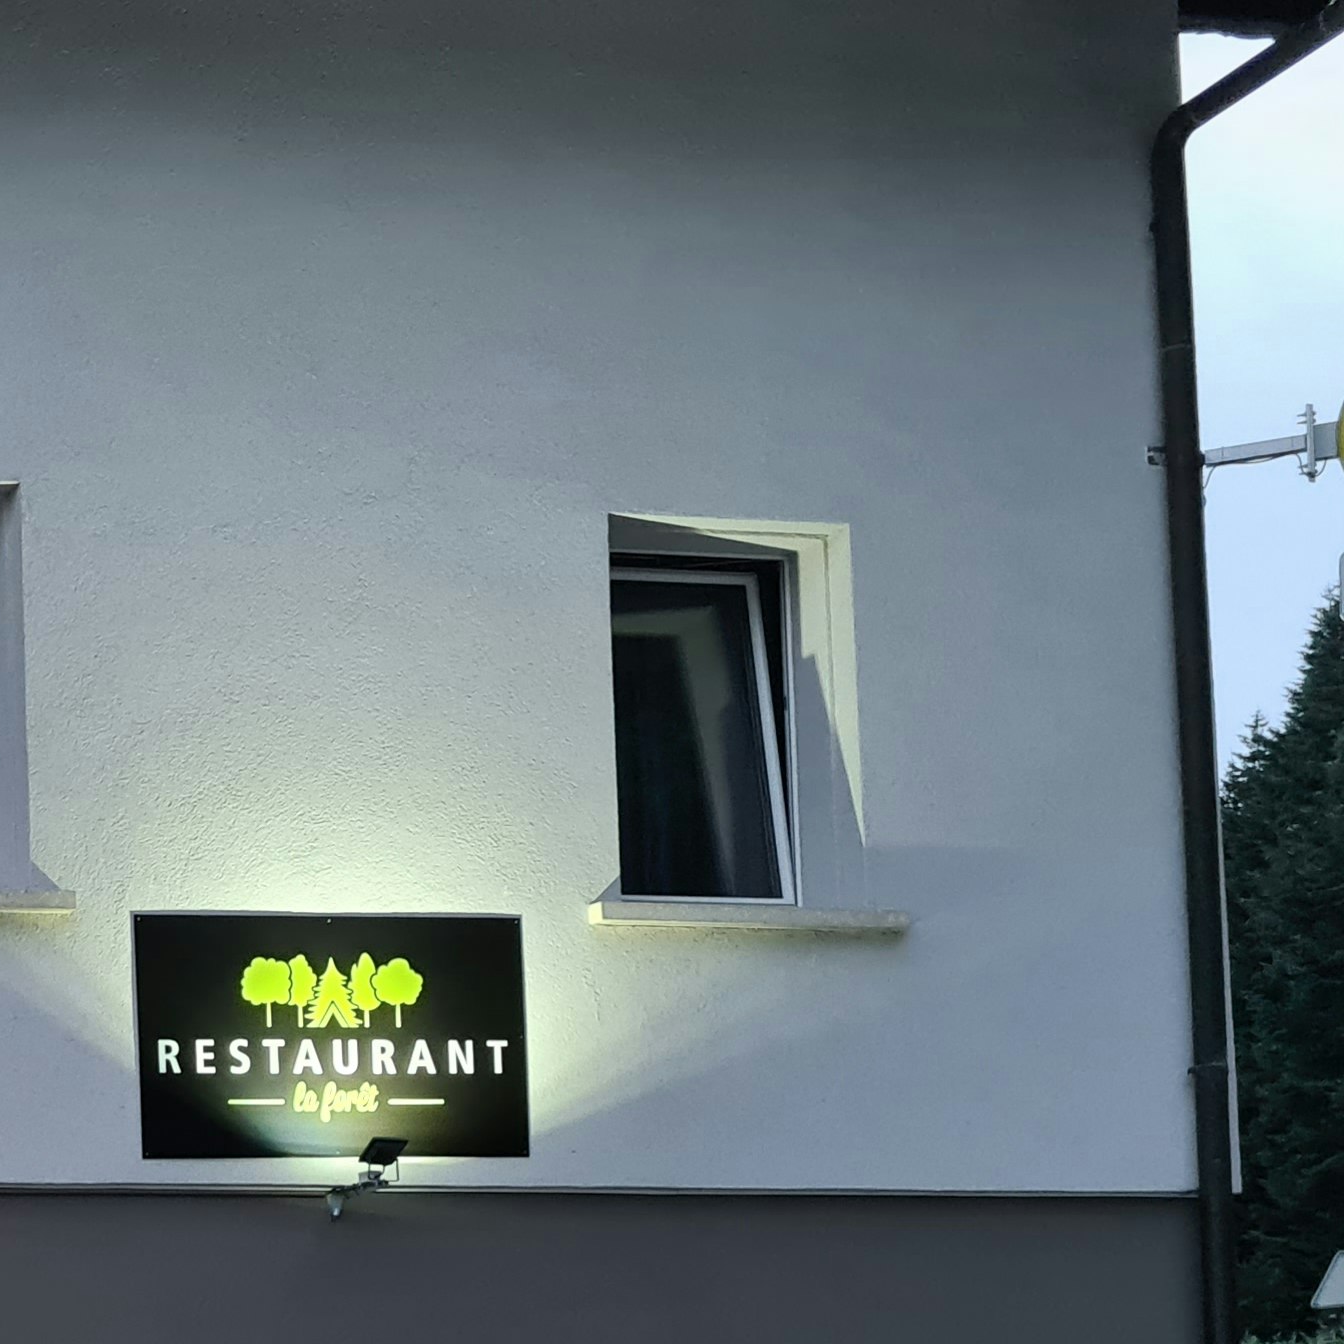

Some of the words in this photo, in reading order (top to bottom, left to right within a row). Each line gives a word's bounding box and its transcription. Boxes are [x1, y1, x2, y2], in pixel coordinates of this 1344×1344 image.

[157, 1038, 509, 1075] RESTAURANT
[292, 1081, 319, 1113] la
[319, 1081, 380, 1123] forêt
